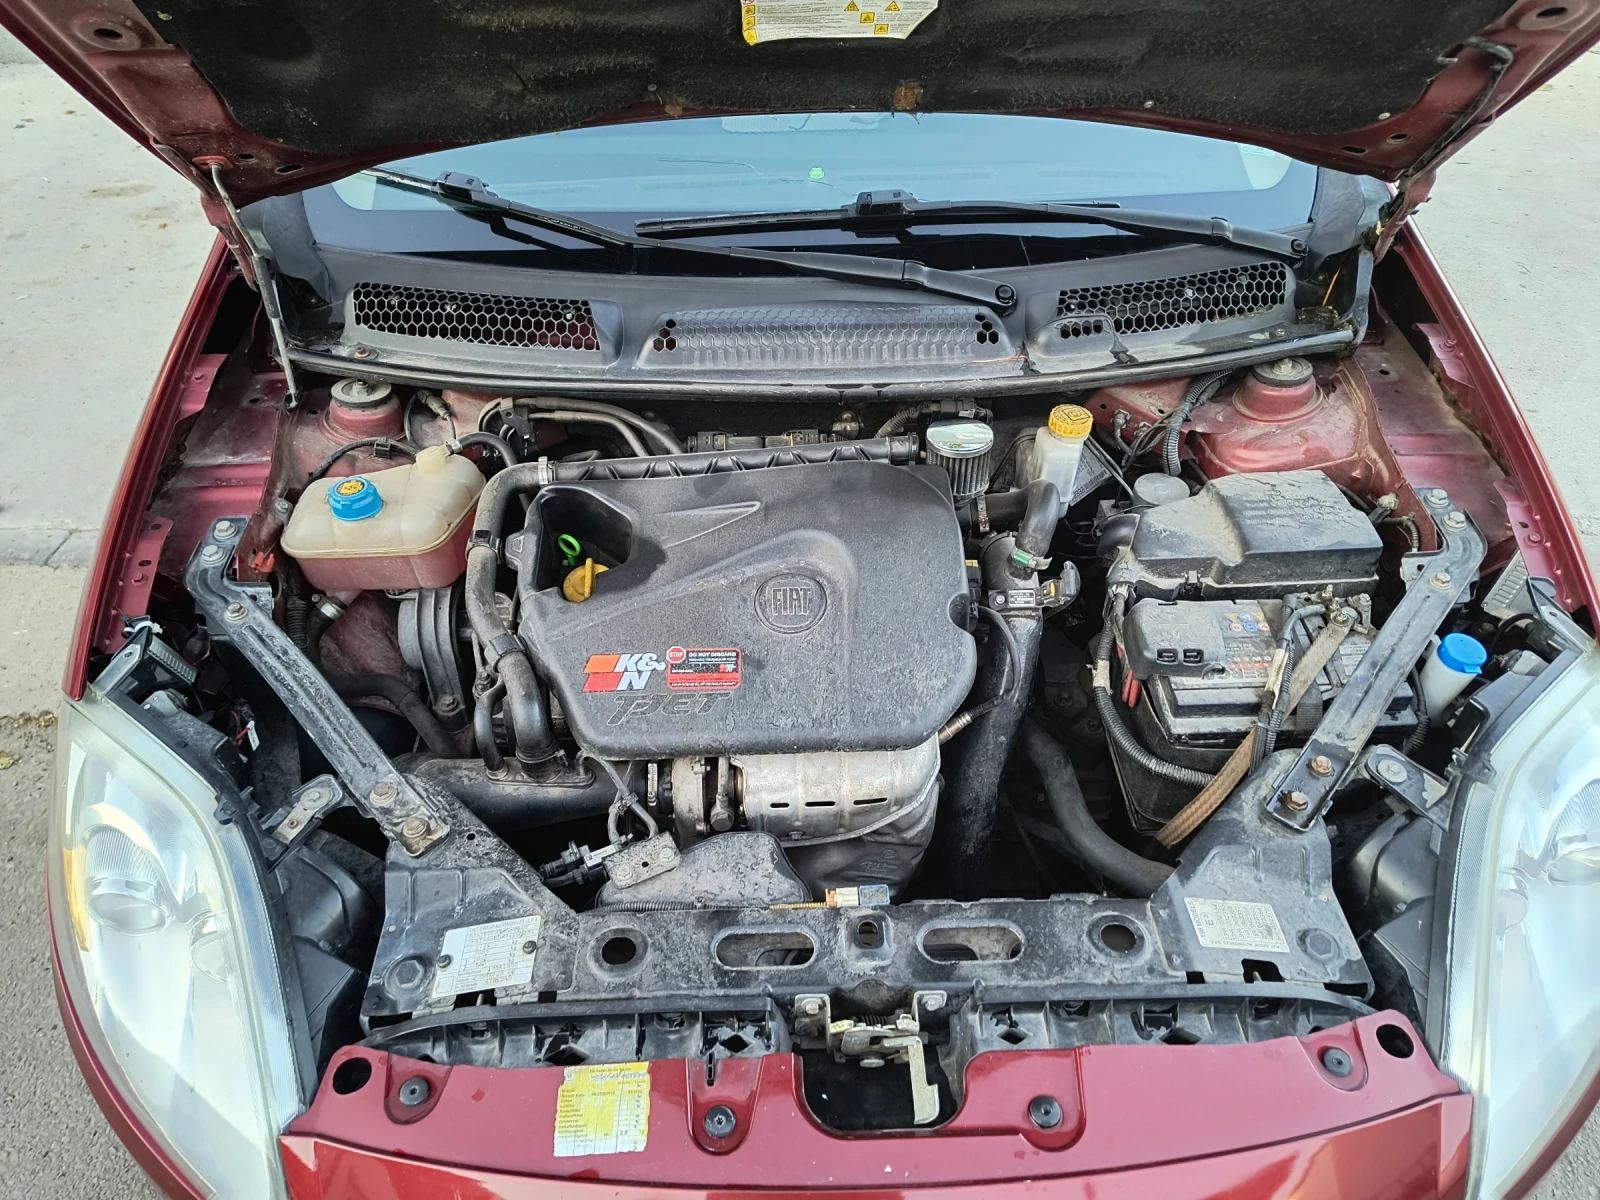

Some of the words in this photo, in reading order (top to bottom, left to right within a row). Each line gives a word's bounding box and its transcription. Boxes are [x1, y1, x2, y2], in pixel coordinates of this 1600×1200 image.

[771, 587, 811, 616] FIAT
[1187, 900, 1203, 927] MODELS
[1197, 927, 1206, 938] 198
